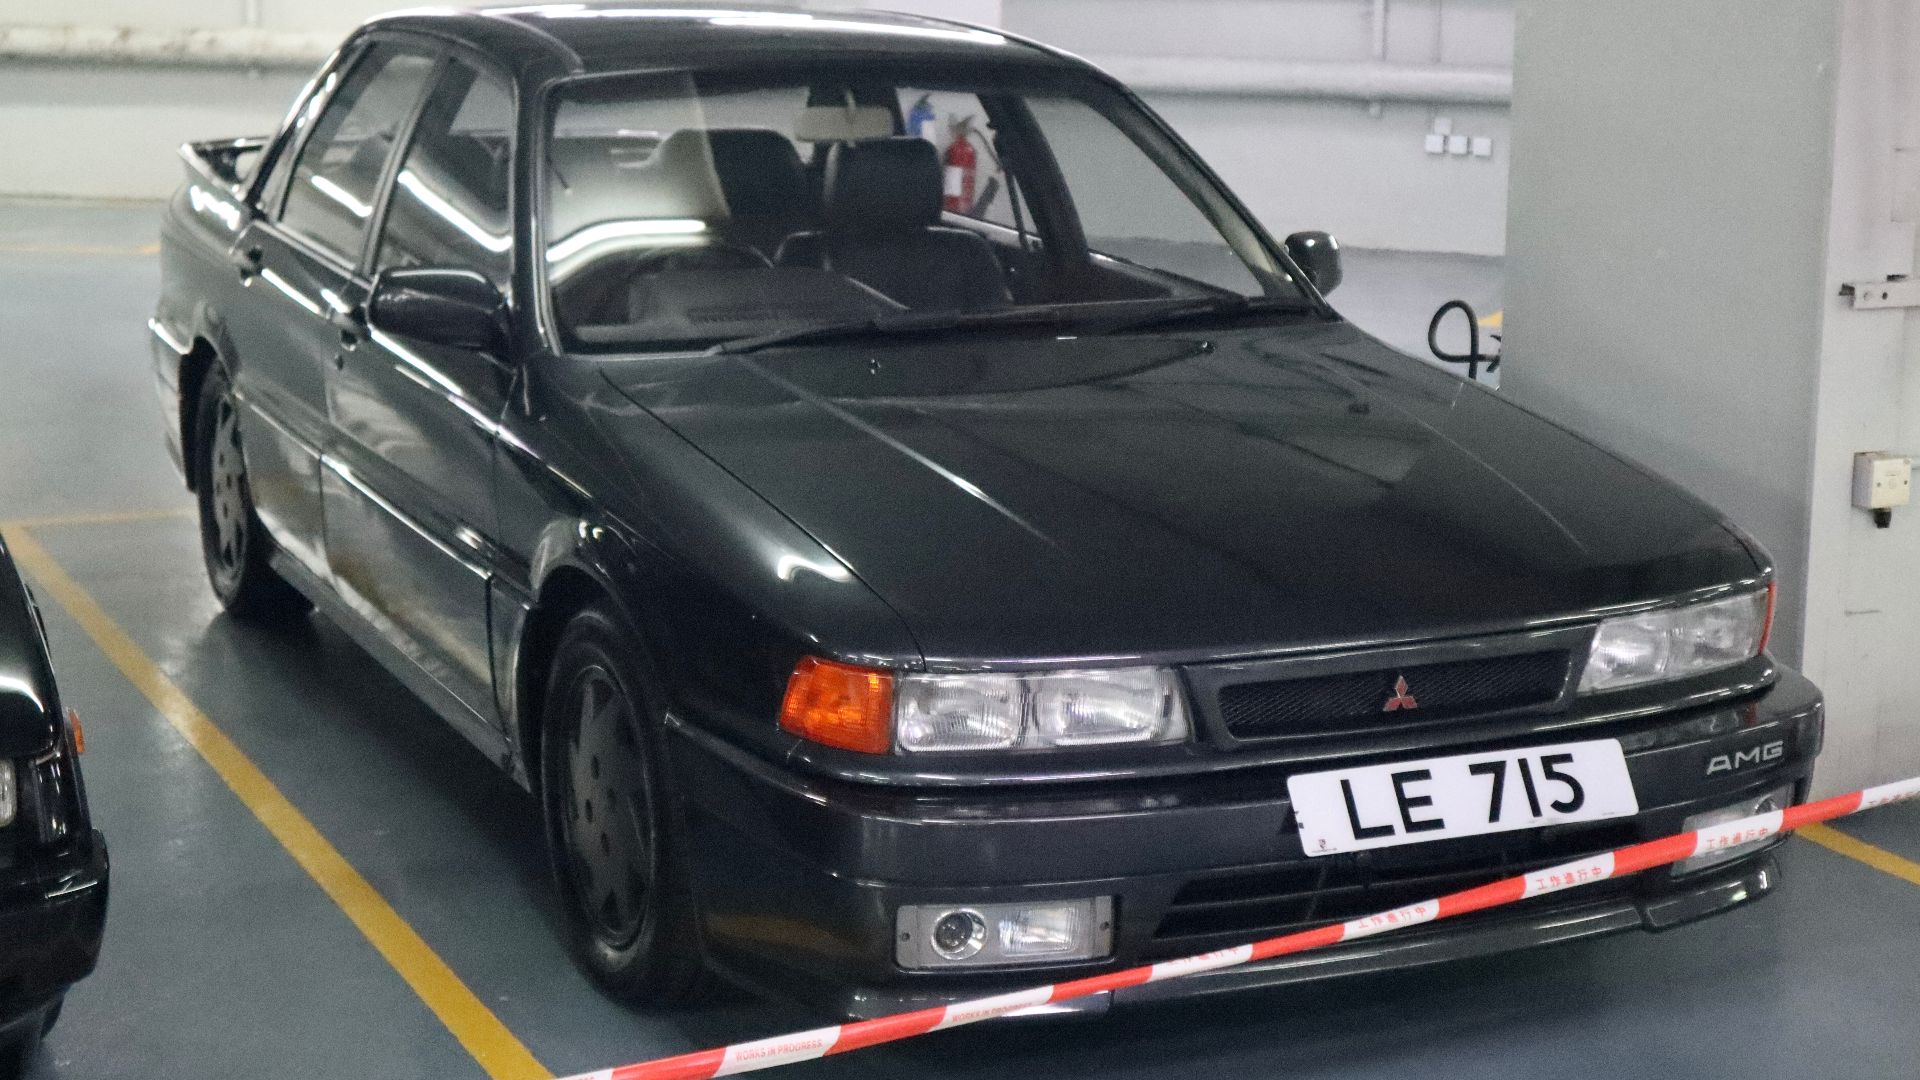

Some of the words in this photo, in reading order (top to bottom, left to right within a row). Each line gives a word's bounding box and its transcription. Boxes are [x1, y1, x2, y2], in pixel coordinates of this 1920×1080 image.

[1706, 741, 1783, 775] AMG
[1340, 769, 1445, 840] LE
[1468, 753, 1585, 824] 715
[735, 1047, 766, 1061] WORKS
[767, 1045, 776, 1056] IN
[778, 1039, 824, 1055] PROGRESS
